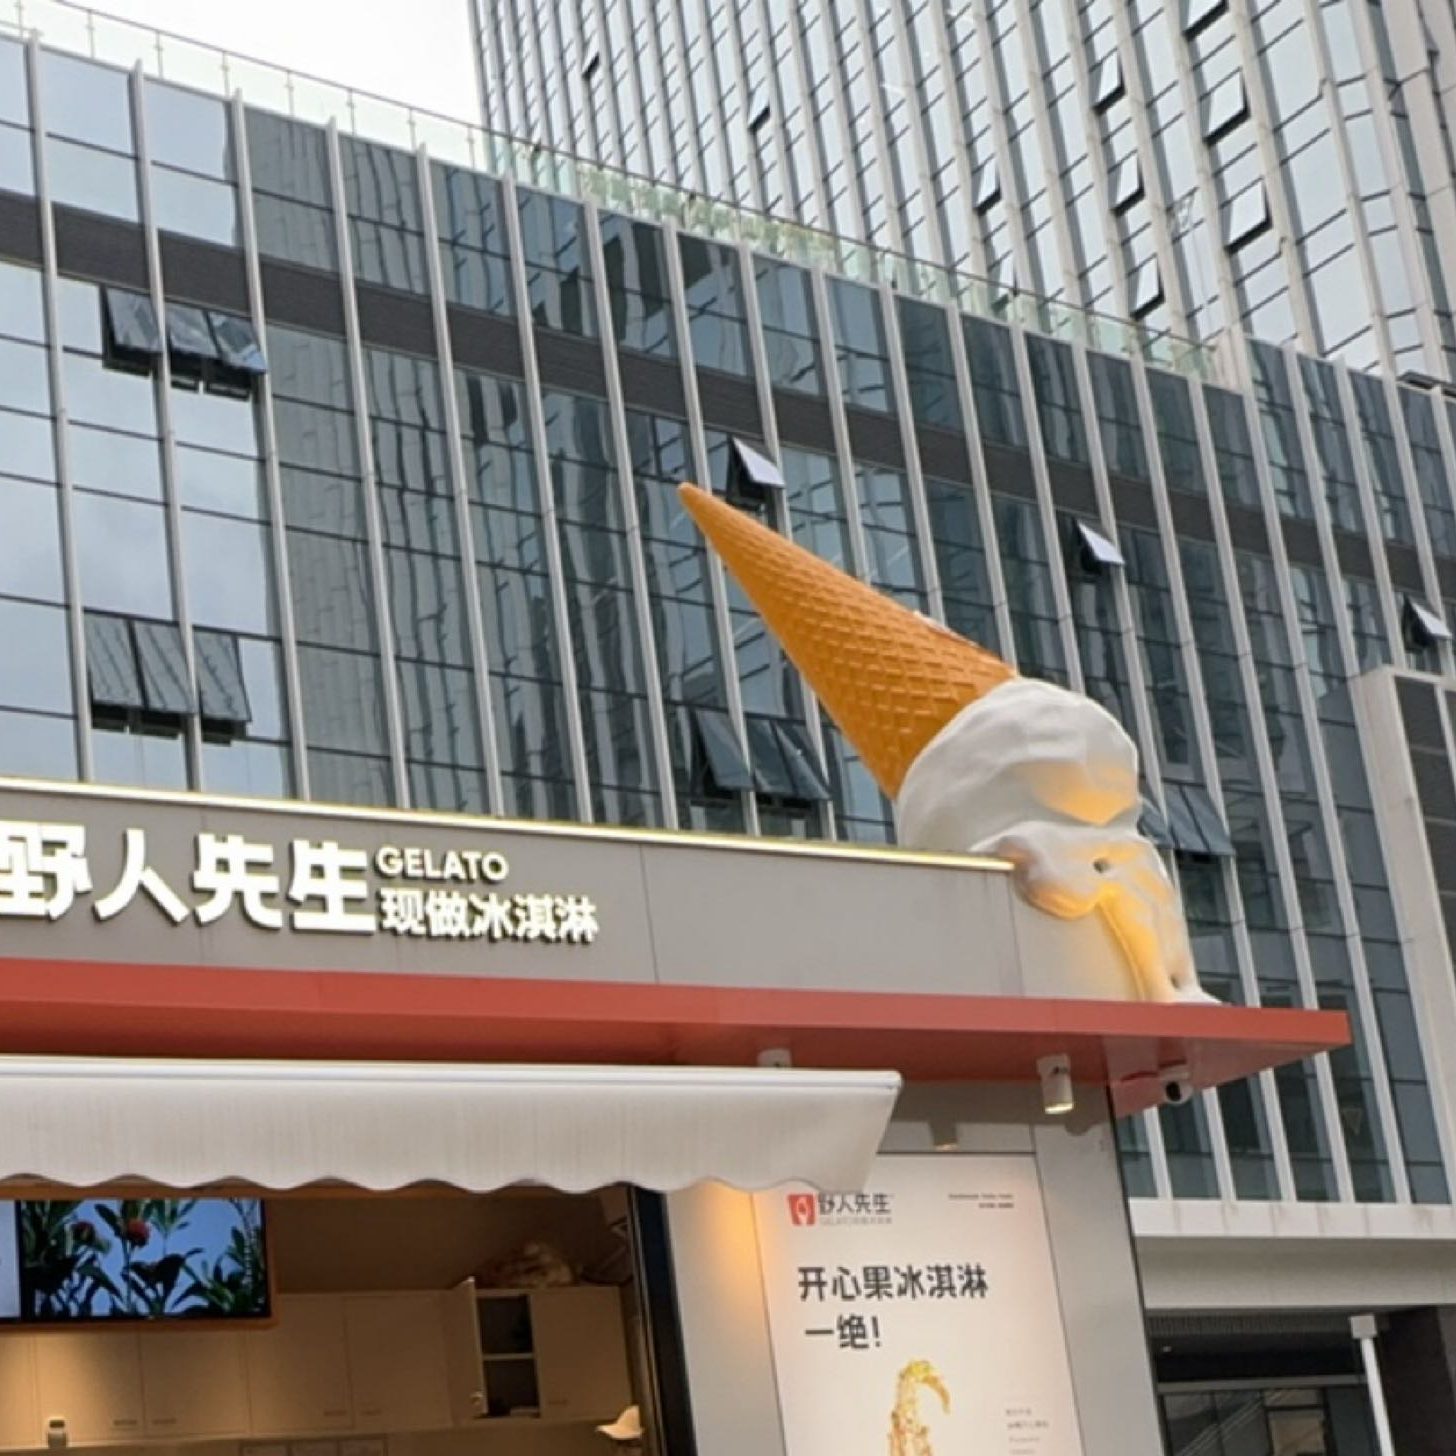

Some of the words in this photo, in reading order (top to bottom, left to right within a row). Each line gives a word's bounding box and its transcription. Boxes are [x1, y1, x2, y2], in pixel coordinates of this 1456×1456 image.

[376, 846, 509, 881] GELATO
[379, 887, 599, 943] 现做冰淇淋
[797, 1262, 989, 1301] 开心果冰淇淋
[805, 1312, 882, 1350] 一绝!
